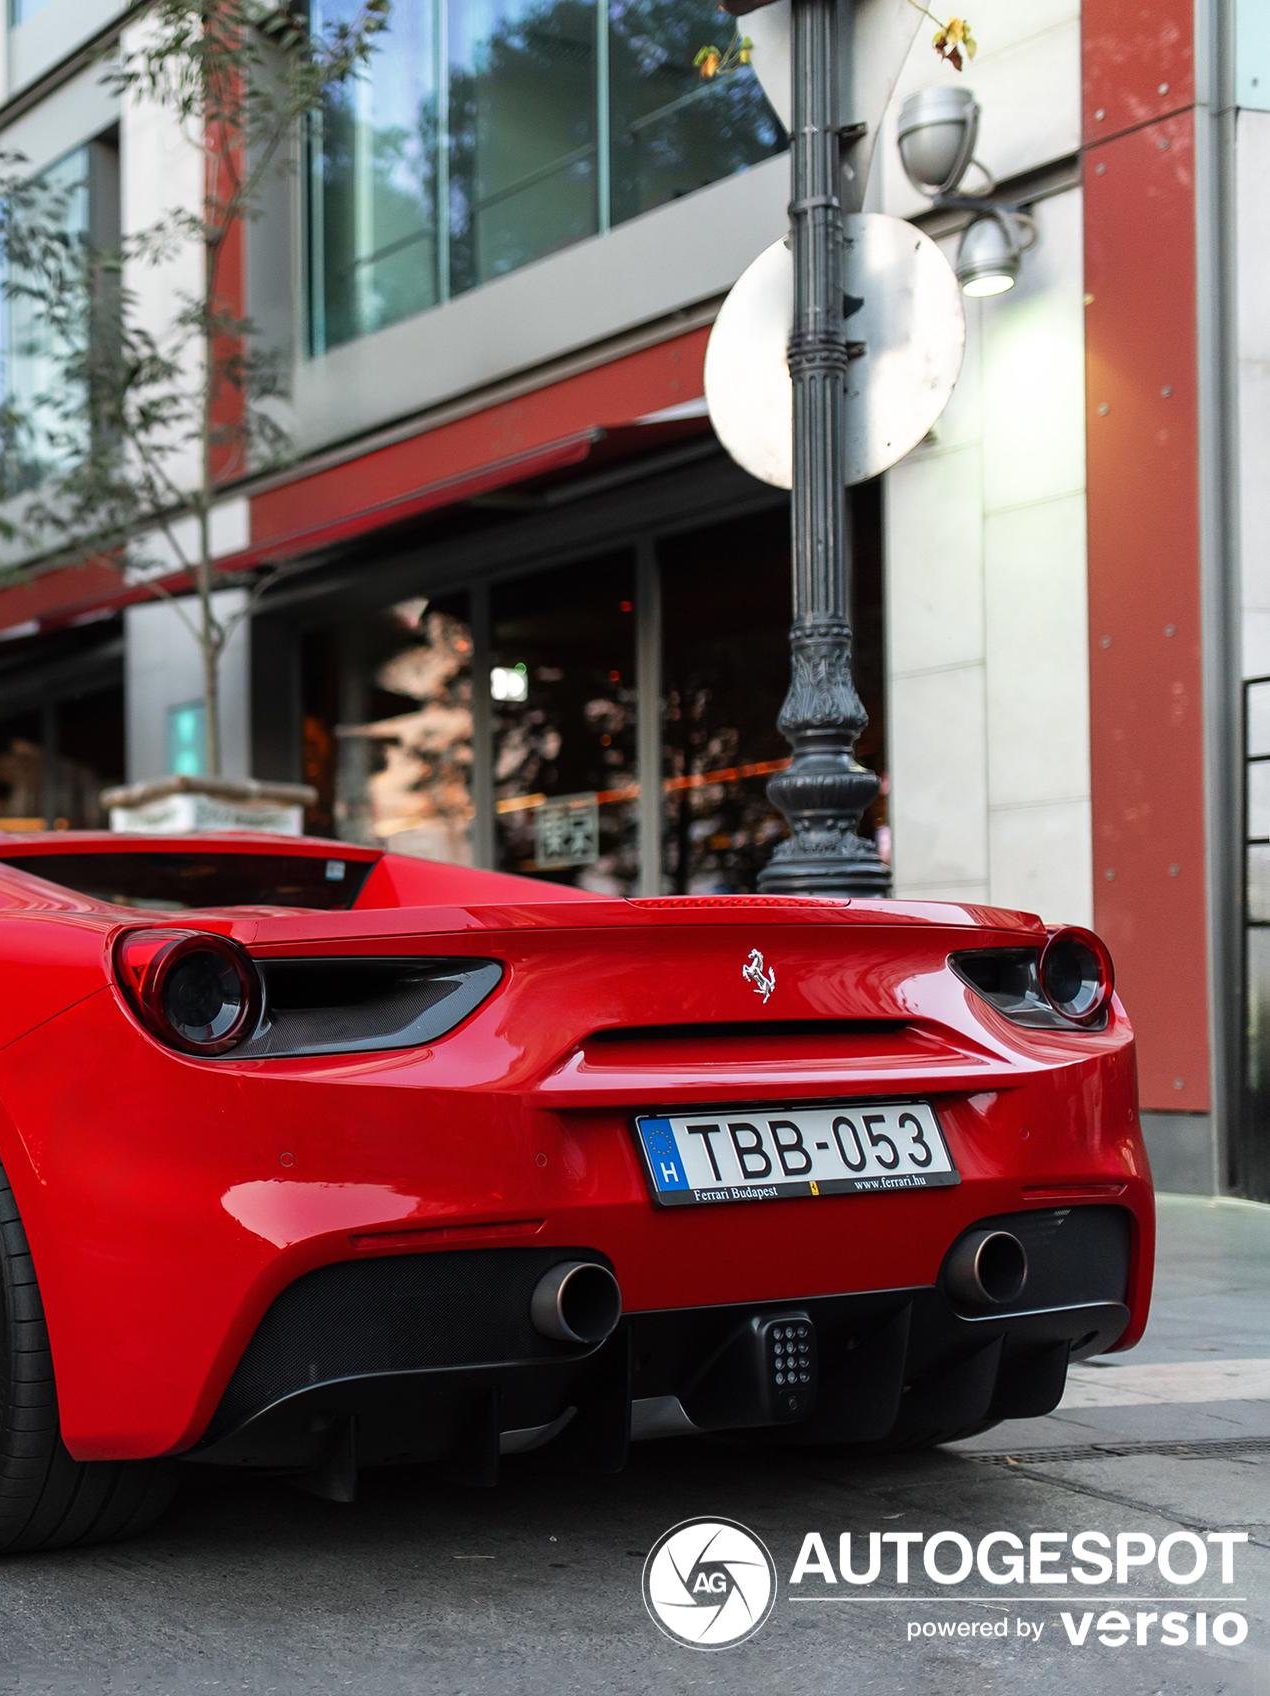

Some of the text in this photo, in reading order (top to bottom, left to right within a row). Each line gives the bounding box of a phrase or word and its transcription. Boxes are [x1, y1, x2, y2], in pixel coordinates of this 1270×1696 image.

[685, 1112, 933, 1181] TBB-053
[660, 1161, 679, 1183] H
[854, 1174, 927, 1190] www.ferrari.hu
[693, 1185, 779, 1201] Ferrari Budapest
